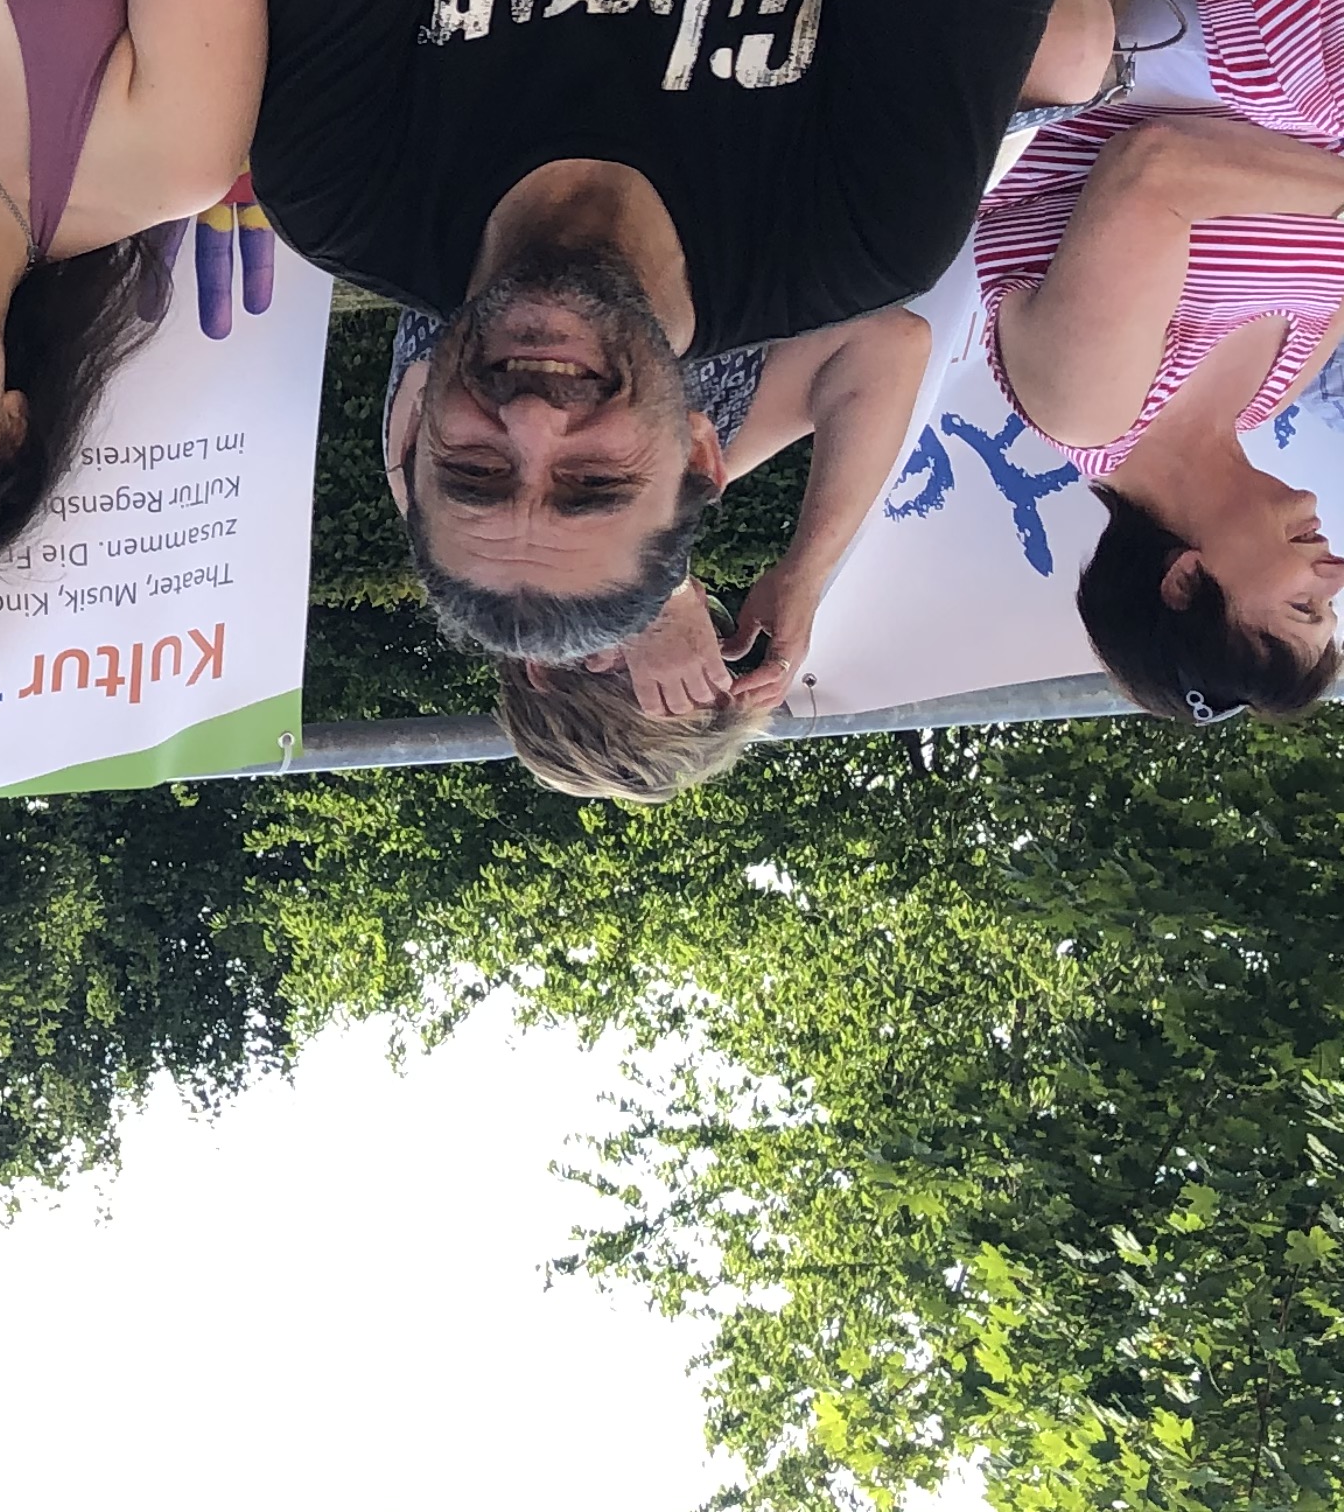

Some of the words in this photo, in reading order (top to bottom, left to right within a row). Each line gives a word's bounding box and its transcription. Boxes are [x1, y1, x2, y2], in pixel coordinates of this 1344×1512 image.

[81, 438, 207, 470] Landkreis
[216, 433, 245, 454] im
[46, 482, 162, 522] Regensb
[169, 476, 240, 511] KulTür
[43, 543, 87, 568] Die
[99, 519, 238, 558] zusammen.
[59, 581, 136, 614] Musik,
[147, 562, 234, 599] Theater,
[19, 623, 225, 703] Kultur
